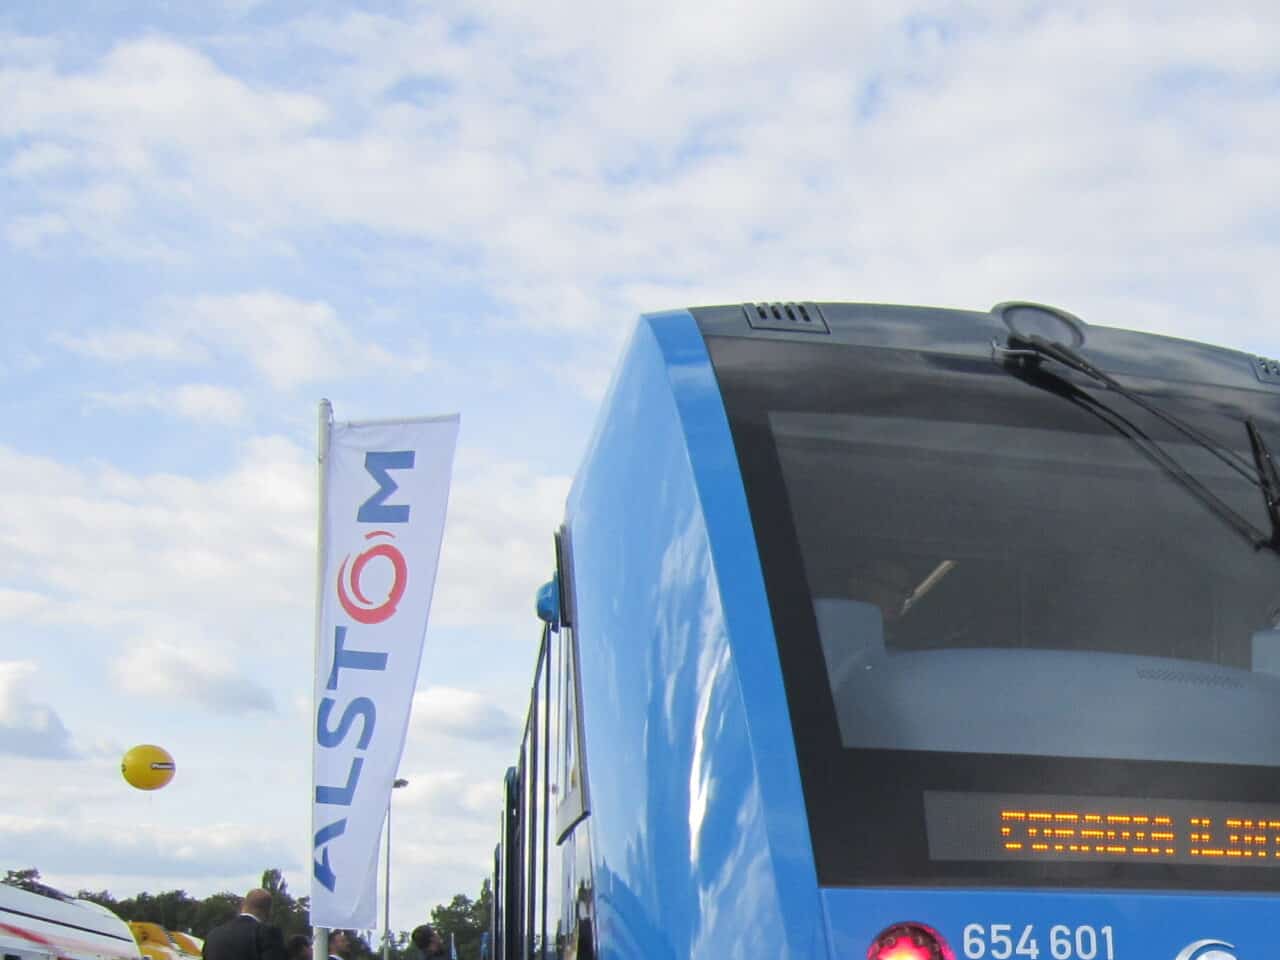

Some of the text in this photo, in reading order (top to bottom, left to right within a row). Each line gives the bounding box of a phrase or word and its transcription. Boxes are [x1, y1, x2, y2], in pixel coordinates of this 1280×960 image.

[311, 450, 416, 893] ALSTOM
[963, 923, 1115, 960] 654 601
